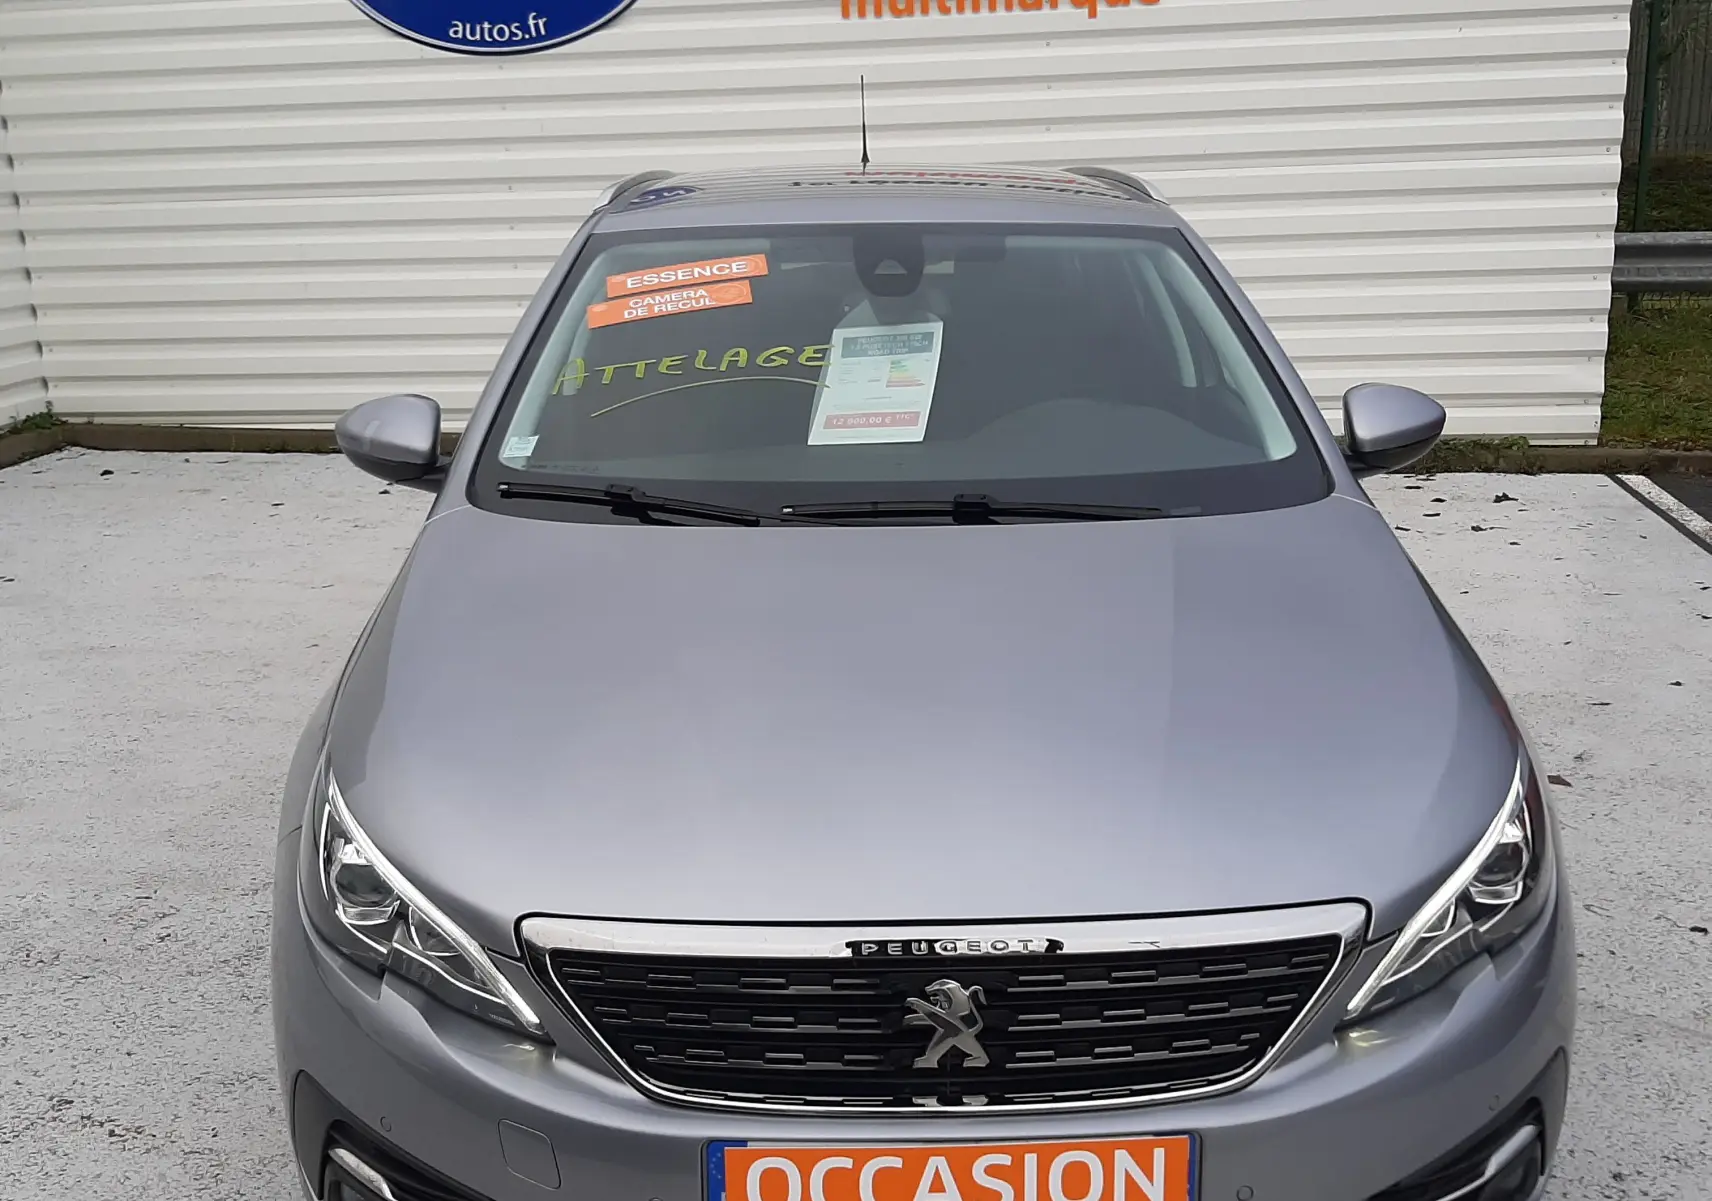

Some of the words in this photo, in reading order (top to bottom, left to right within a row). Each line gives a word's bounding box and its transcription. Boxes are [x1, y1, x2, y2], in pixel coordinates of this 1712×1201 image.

[449, 12, 548, 42] autos.fr
[626, 261, 748, 289] ESSENCE
[623, 308, 649, 319] DE
[654, 298, 717, 314] RECUL
[629, 288, 709, 309] CAMERA
[552, 344, 835, 395] ATTELAGE
[861, 939, 1034, 956] PEUGEOT
[746, 1147, 1165, 1201] OCCASION
